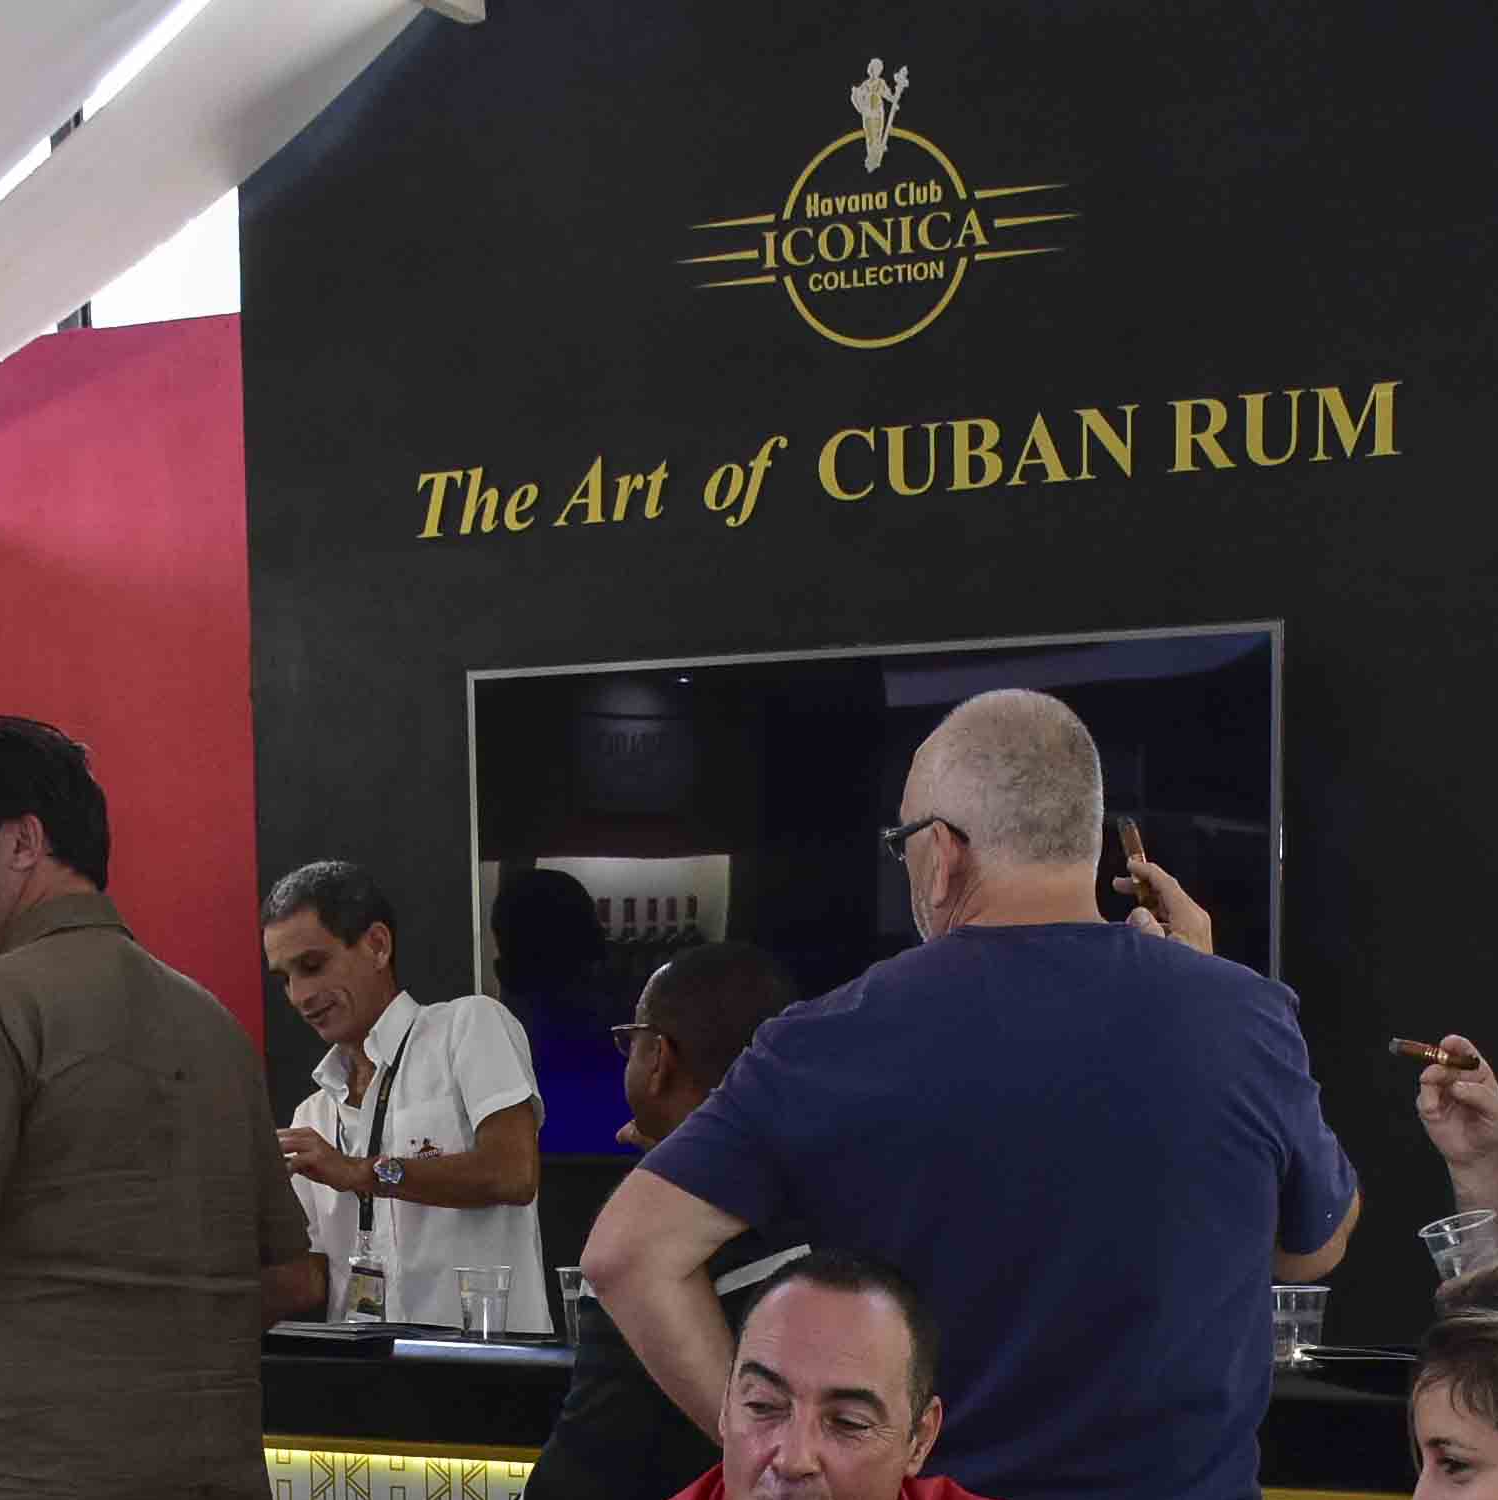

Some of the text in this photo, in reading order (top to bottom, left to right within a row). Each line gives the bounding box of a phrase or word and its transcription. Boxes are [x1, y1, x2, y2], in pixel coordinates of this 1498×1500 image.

[805, 179, 943, 219] Havana Club
[761, 207, 990, 271] ICONICA
[808, 259, 945, 293] COLLECTION
[415, 379, 1403, 539] The Art of CUBAN RUM
